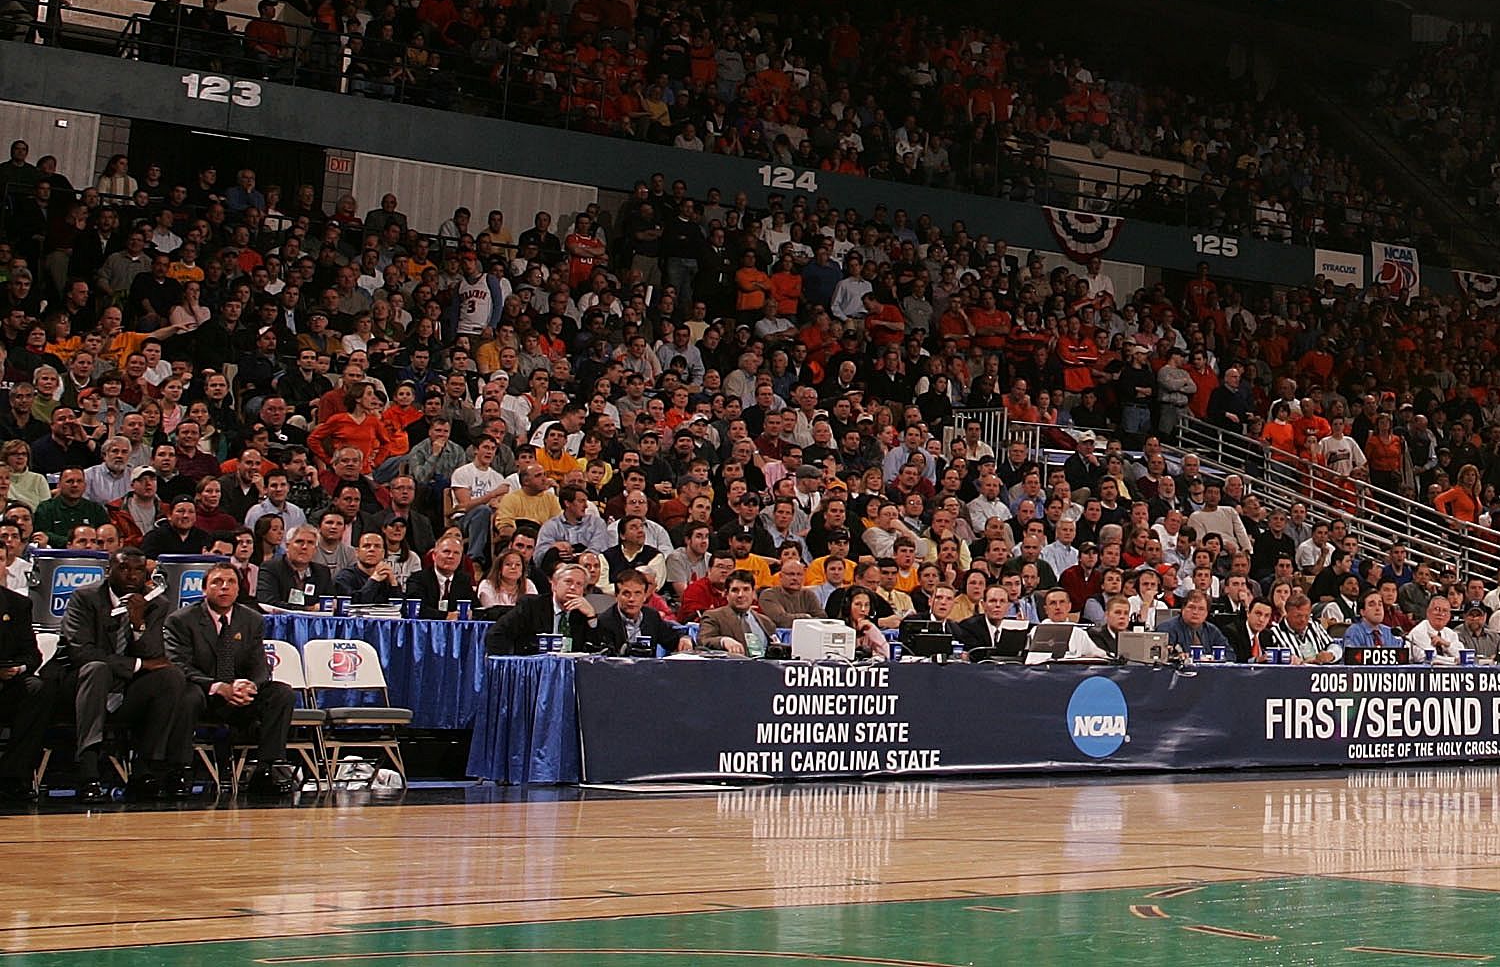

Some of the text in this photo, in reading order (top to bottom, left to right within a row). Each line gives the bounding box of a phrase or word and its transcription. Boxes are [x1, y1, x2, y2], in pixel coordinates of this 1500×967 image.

[181, 73, 263, 108] 123
[330, 158, 353, 172] EXIT
[758, 164, 819, 194] 124
[1192, 233, 1239, 259] 125
[1383, 246, 1414, 262] NCAA
[1321, 263, 1357, 275] SYRACUSE
[466, 300, 476, 313] 3
[333, 642, 358, 650] NCAA
[1363, 649, 1399, 665] POSS.
[784, 666, 889, 688] CHARLOTTE
[1310, 673, 1348, 693] 2005
[1353, 673, 1416, 693] DIVISION
[1419, 673, 1425, 692] I
[1429, 672, 1475, 692] MEN'S
[772, 694, 899, 716] CONNECTICUT
[1074, 716, 1126, 737] NCAA
[1265, 697, 1482, 740] FIRST/SECOND
[756, 722, 910, 744] MICHIGAN STATE
[1348, 742, 1396, 759] COLLEGE
[1397, 741, 1412, 758] OF
[1413, 741, 1434, 757] THE
[1436, 741, 1463, 757] HOLY
[719, 749, 941, 773] NORTH CAROLINA STATE
